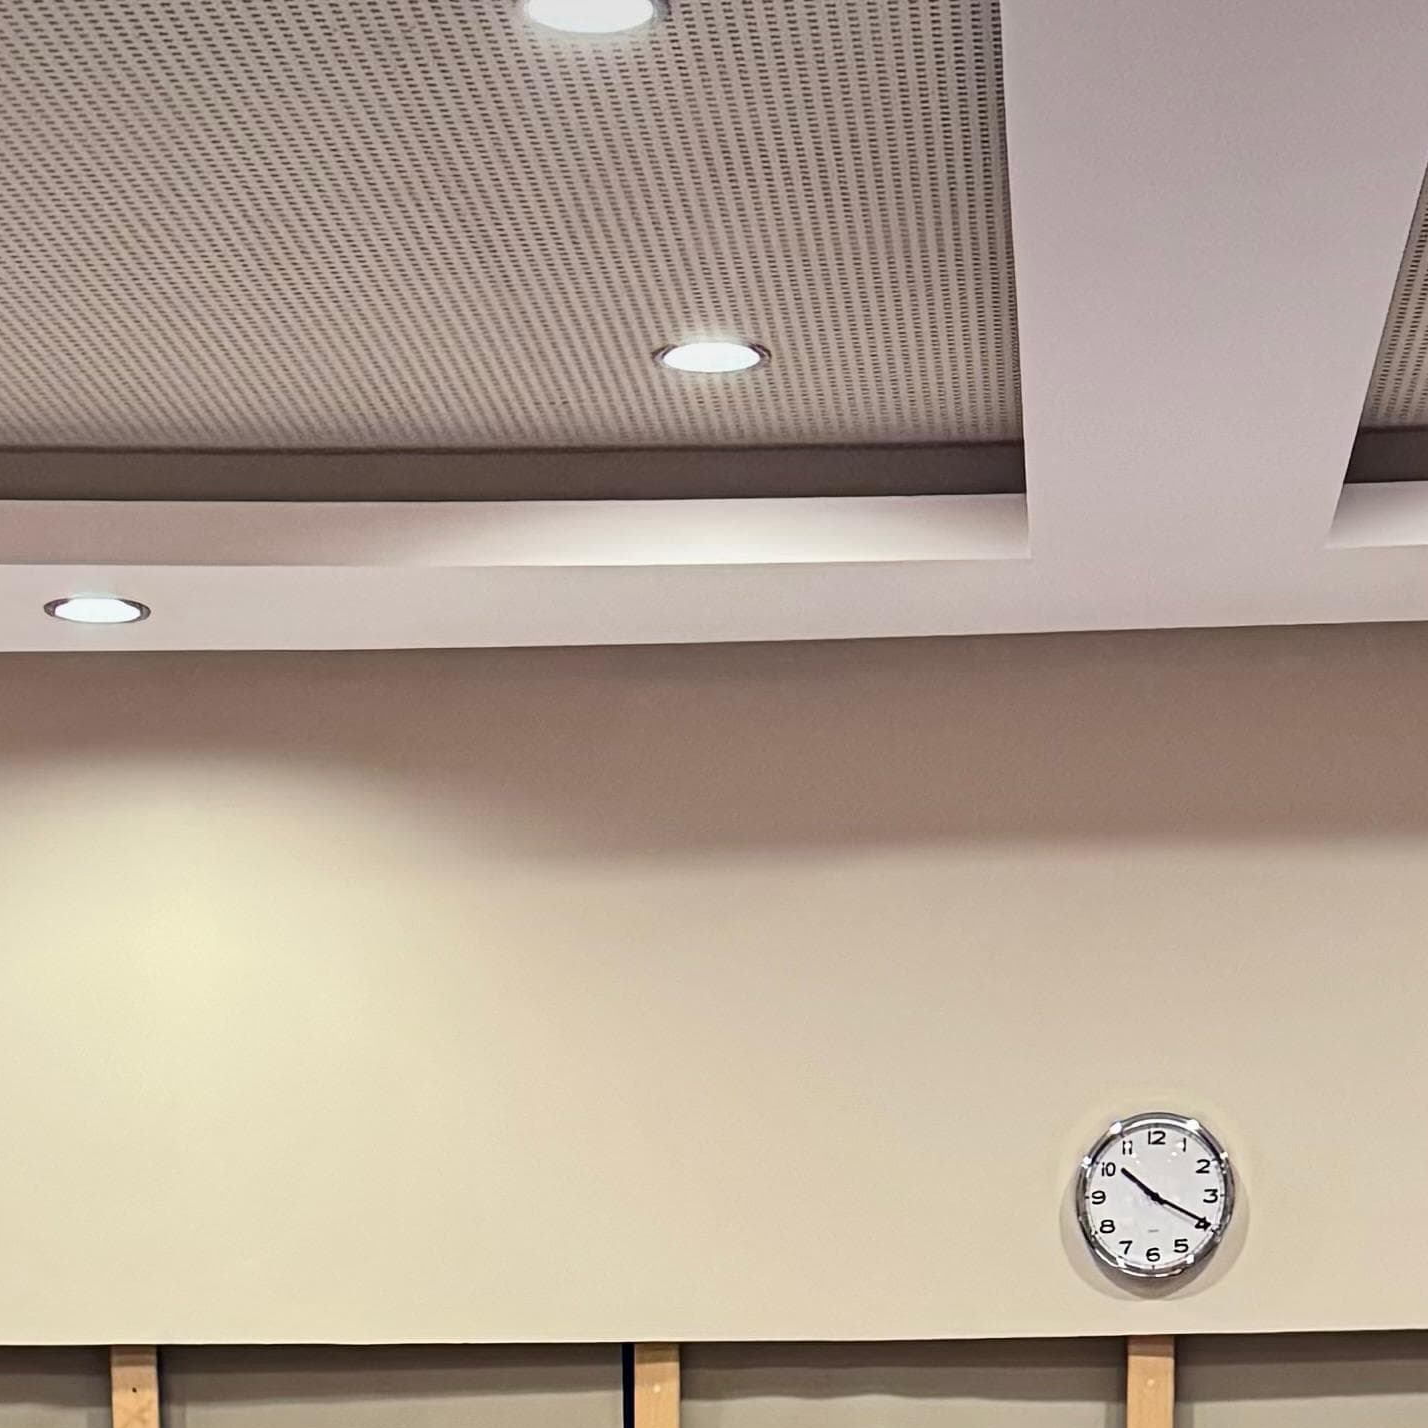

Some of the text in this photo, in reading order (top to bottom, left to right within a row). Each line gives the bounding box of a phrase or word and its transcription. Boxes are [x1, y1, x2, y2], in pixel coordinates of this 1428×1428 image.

[1148, 1131, 1166, 1144] 12
[1101, 1163, 1116, 1176] 10
[1196, 1159, 1210, 1174] 2
[1092, 1191, 1106, 1204] 9
[1203, 1189, 1218, 1203] 3
[1100, 1220, 1115, 1233] 8
[1119, 1241, 1132, 1254] 7
[1174, 1239, 1189, 1253] 5
[1146, 1248, 1160, 1262] 6
